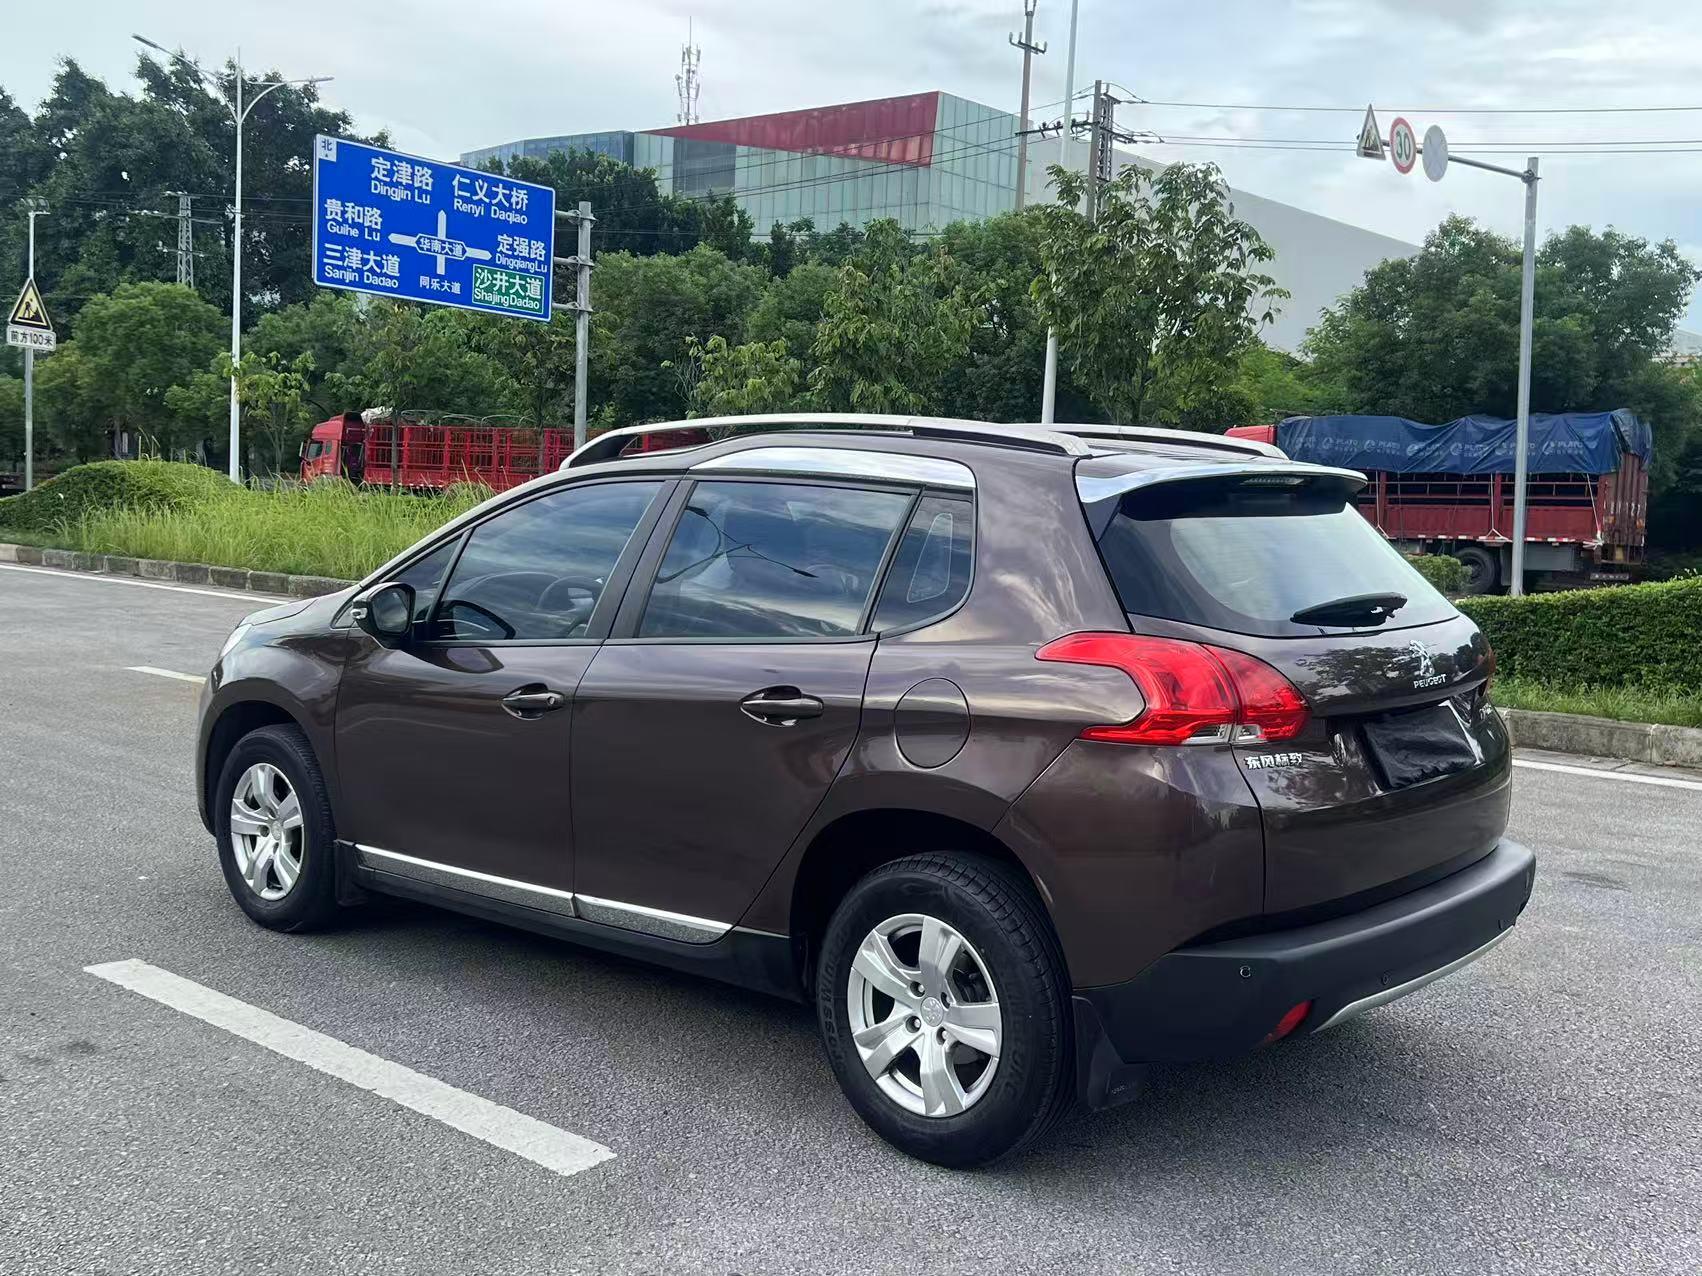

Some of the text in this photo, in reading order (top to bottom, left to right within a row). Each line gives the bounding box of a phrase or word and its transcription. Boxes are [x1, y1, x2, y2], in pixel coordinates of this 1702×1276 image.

[322, 138, 333, 152] 北
[1395, 131, 1411, 161] 30
[371, 157, 434, 191] 定津路
[371, 180, 431, 204] Dingjin Lu
[452, 173, 529, 211] 仁义大桥
[324, 198, 383, 230] 贵和路
[453, 198, 528, 224] Renyi Daqiao
[327, 221, 380, 241] Guihe Lu
[419, 237, 464, 258] 华南大道
[496, 233, 546, 261] 定强路
[323, 243, 400, 277] 三津大道
[324, 265, 399, 288] Sanjin Dadao
[420, 275, 461, 294] 同乐大道
[475, 268, 542, 299] 沙井大道
[1413, 673, 1447, 689] PEUGEOT
[1244, 752, 1303, 769] 东风标致
